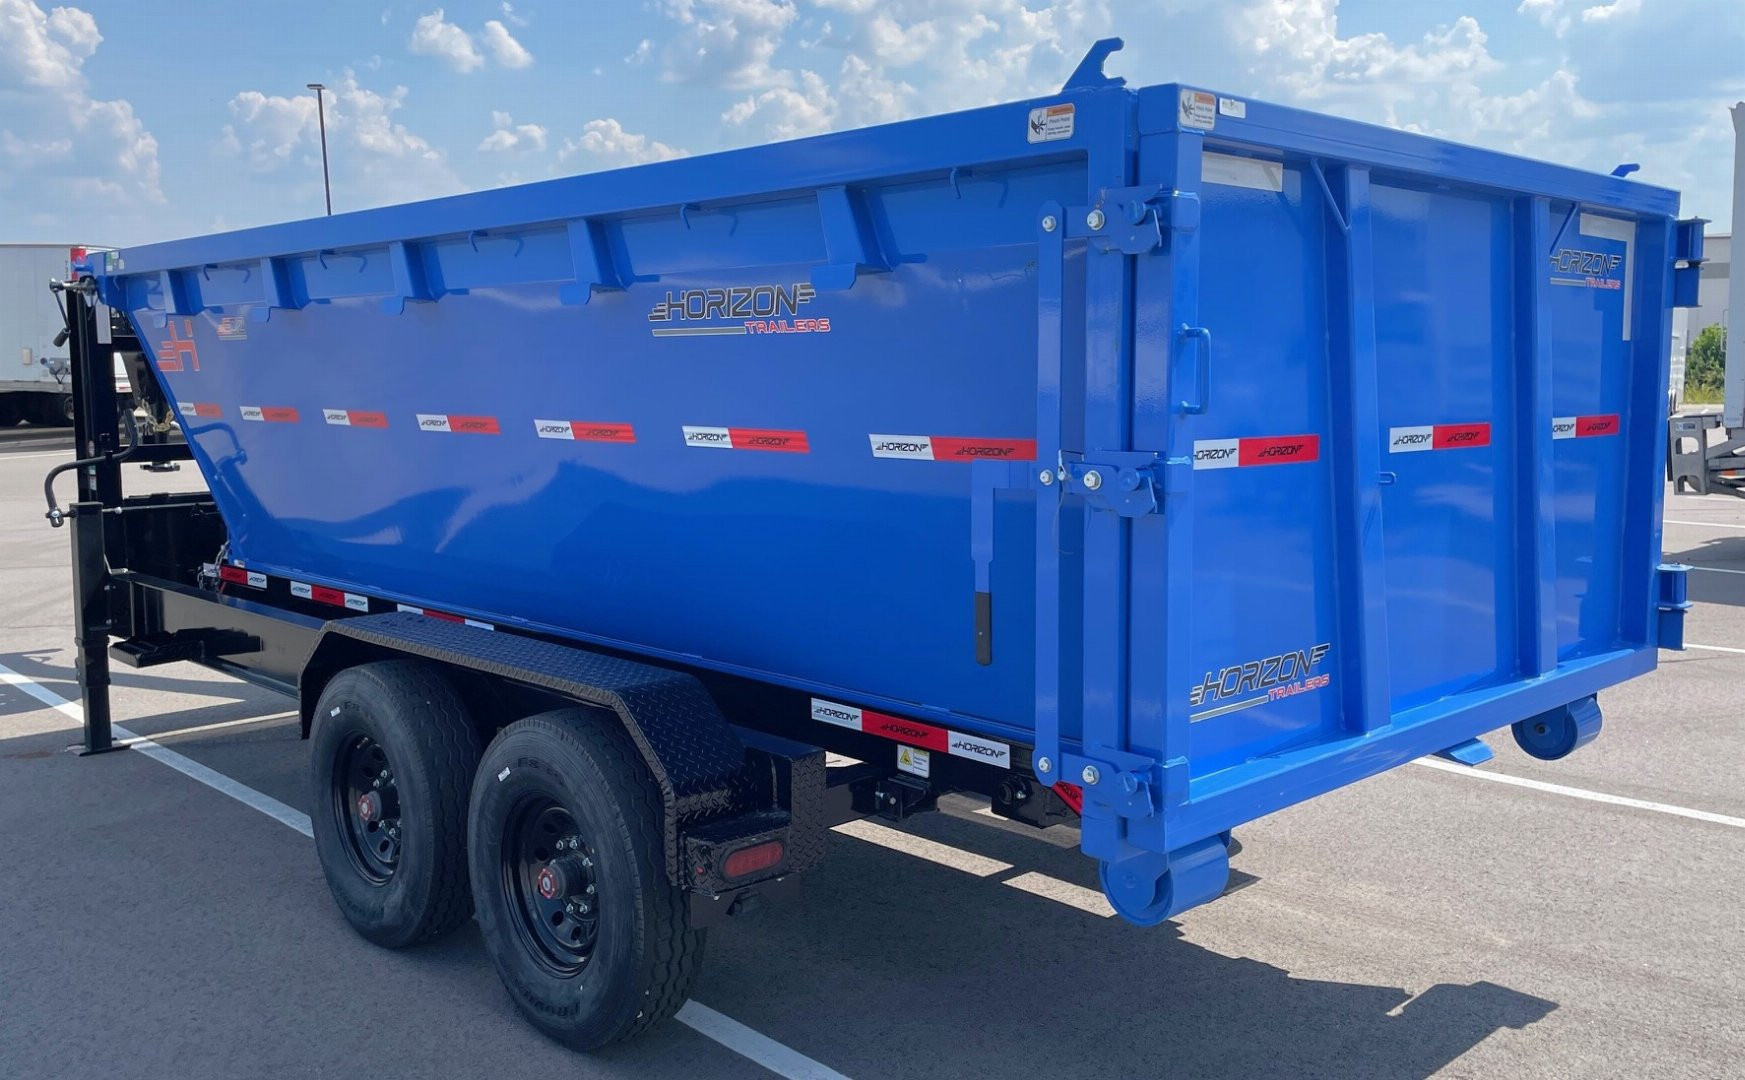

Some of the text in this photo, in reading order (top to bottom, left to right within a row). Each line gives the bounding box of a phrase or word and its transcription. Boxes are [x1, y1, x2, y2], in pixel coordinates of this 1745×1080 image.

[655, 284, 808, 321] HORIZON
[744, 318, 831, 334] TRAILERS
[689, 432, 727, 441] HORIZON
[1394, 434, 1431, 445] HORIZON
[878, 442, 1012, 456] HORIZON HORIZON
[1260, 445, 1303, 457] HORIZON
[1194, 645, 1325, 705] HORIZON
[1268, 674, 1330, 701] TRAILERS
[816, 707, 1005, 758] HORIZON HORIZON HORIZON
